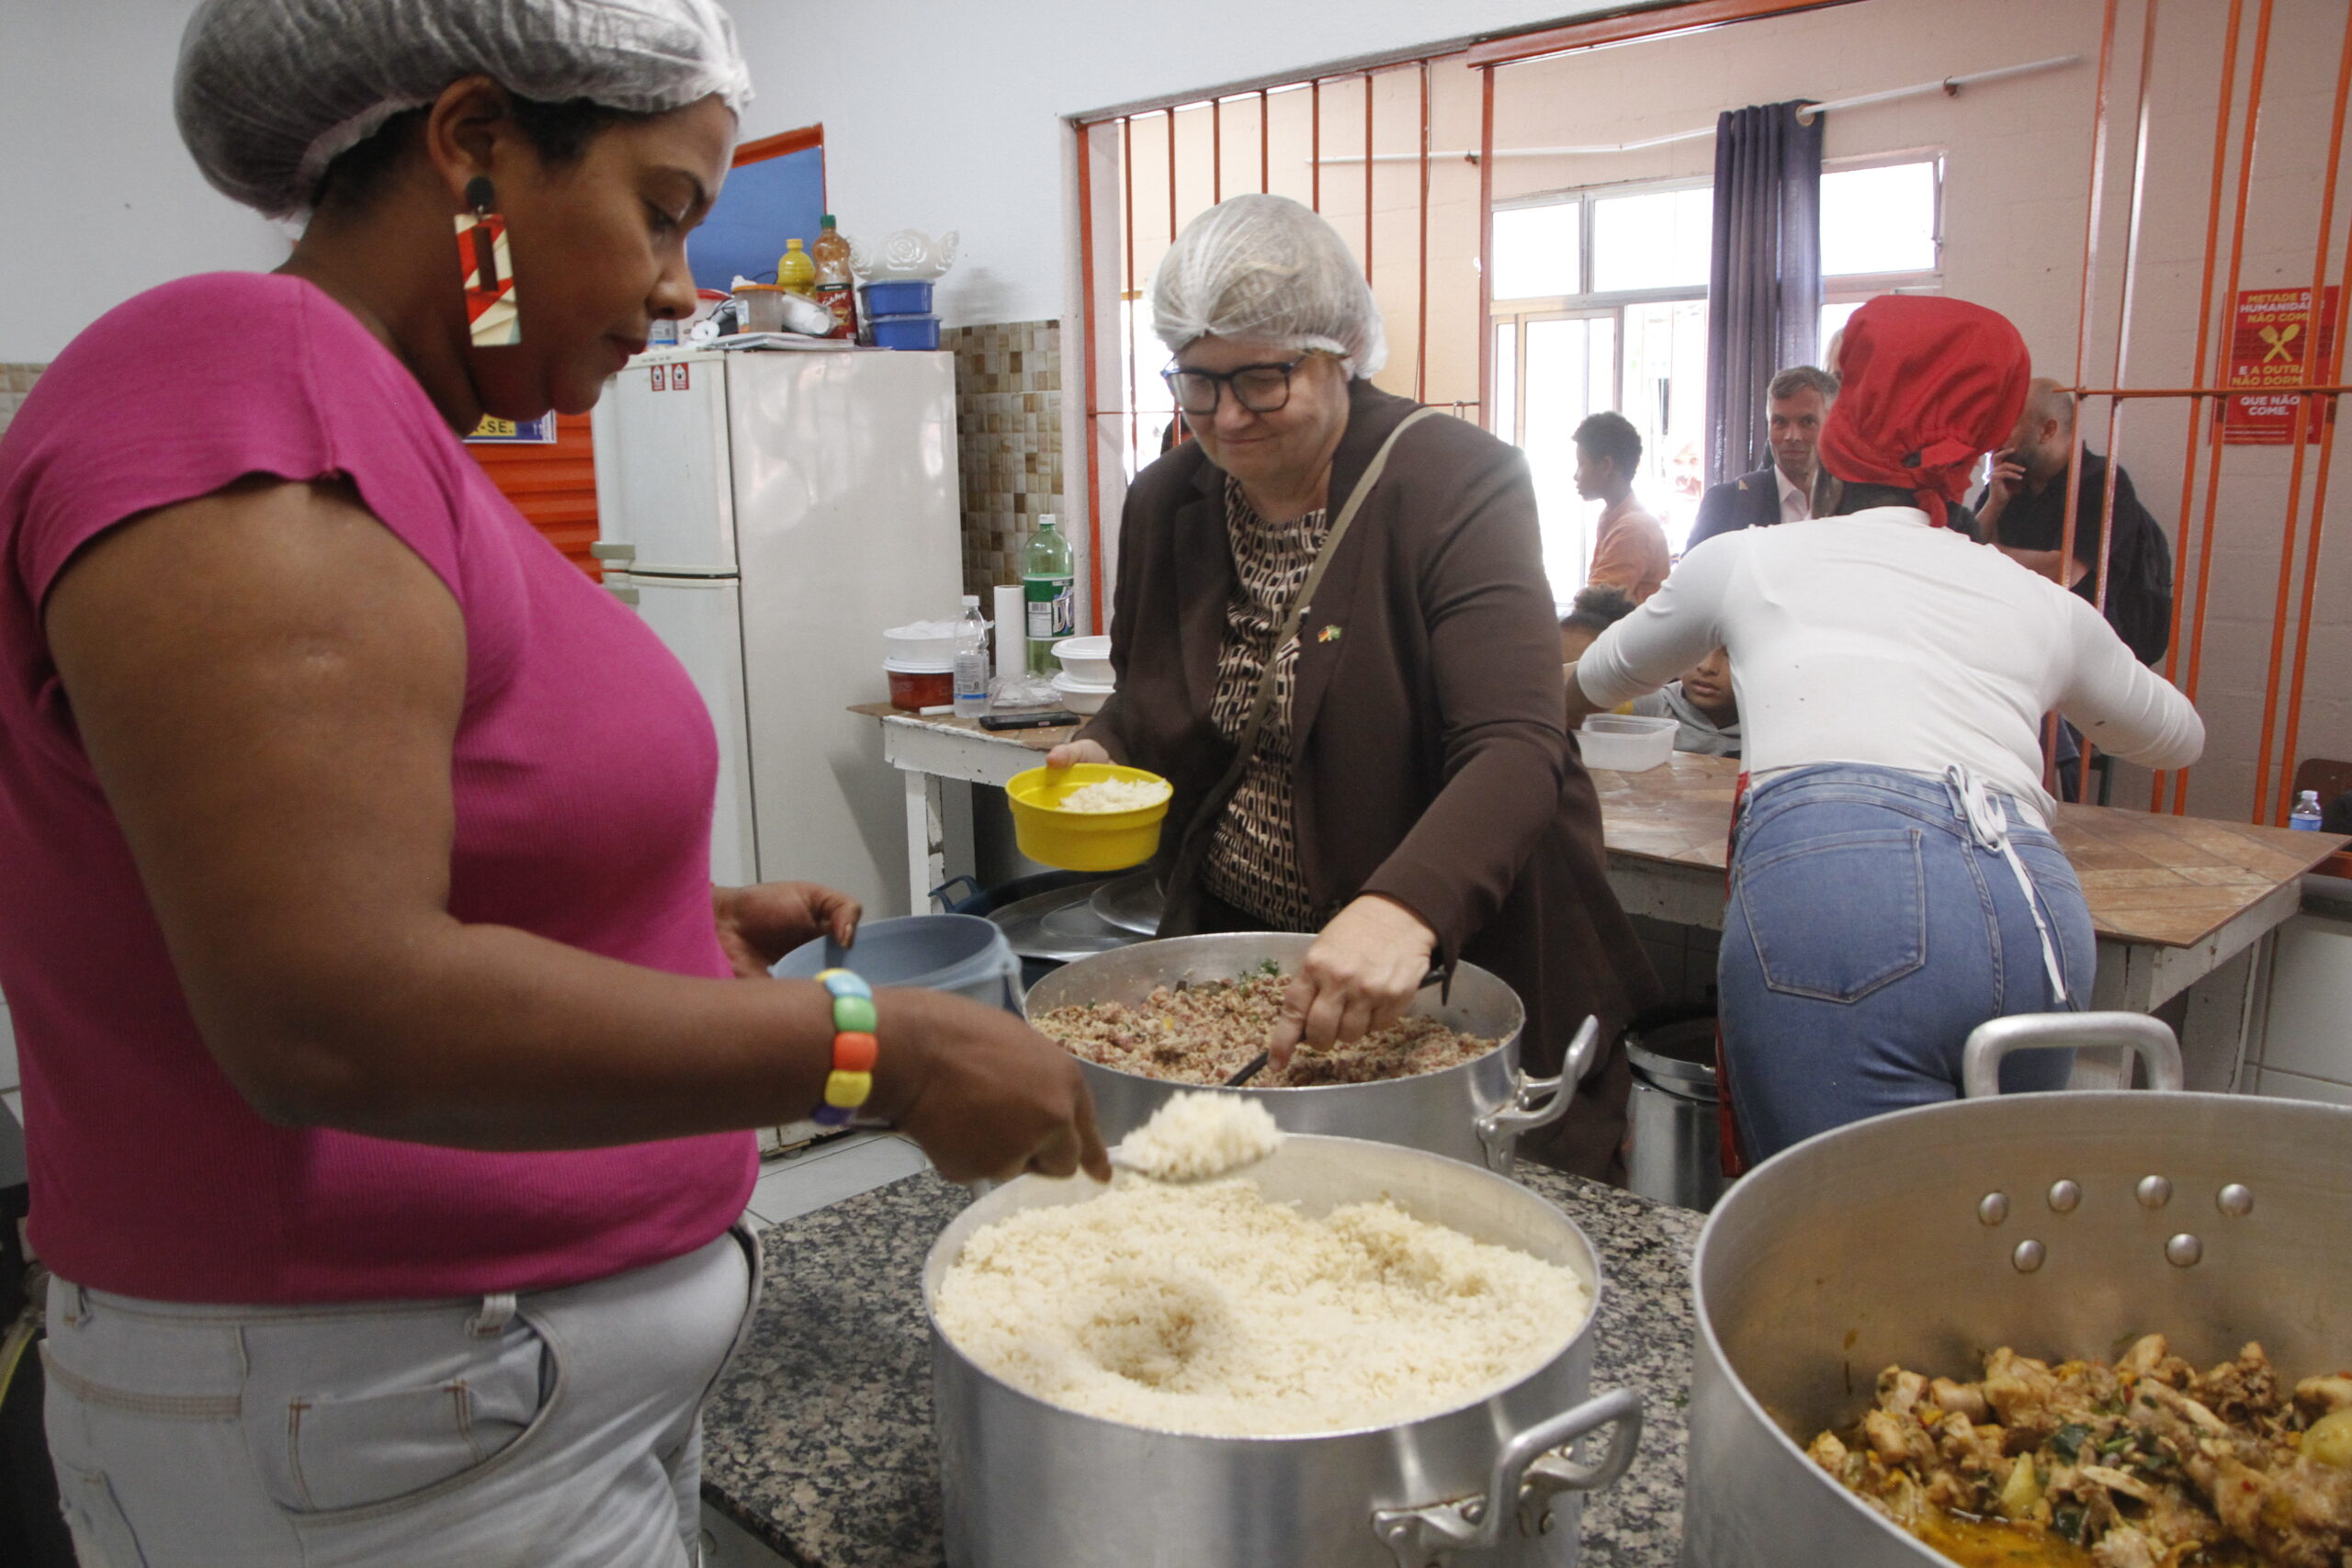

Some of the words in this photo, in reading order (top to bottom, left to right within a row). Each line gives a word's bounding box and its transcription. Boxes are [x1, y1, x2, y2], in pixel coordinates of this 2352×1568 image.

[2247, 293, 2298, 303] METADE
[2247, 313, 2277, 323] NÃO
[2239, 366, 2248, 376] E
[2250, 366, 2260, 375] A
[2232, 375, 2260, 386] NÃO
[2264, 376, 2303, 386] DORM
[2241, 396, 2268, 406] QUE
[2270, 394, 2301, 405] NÃO
[2248, 406, 2290, 416] COME.
